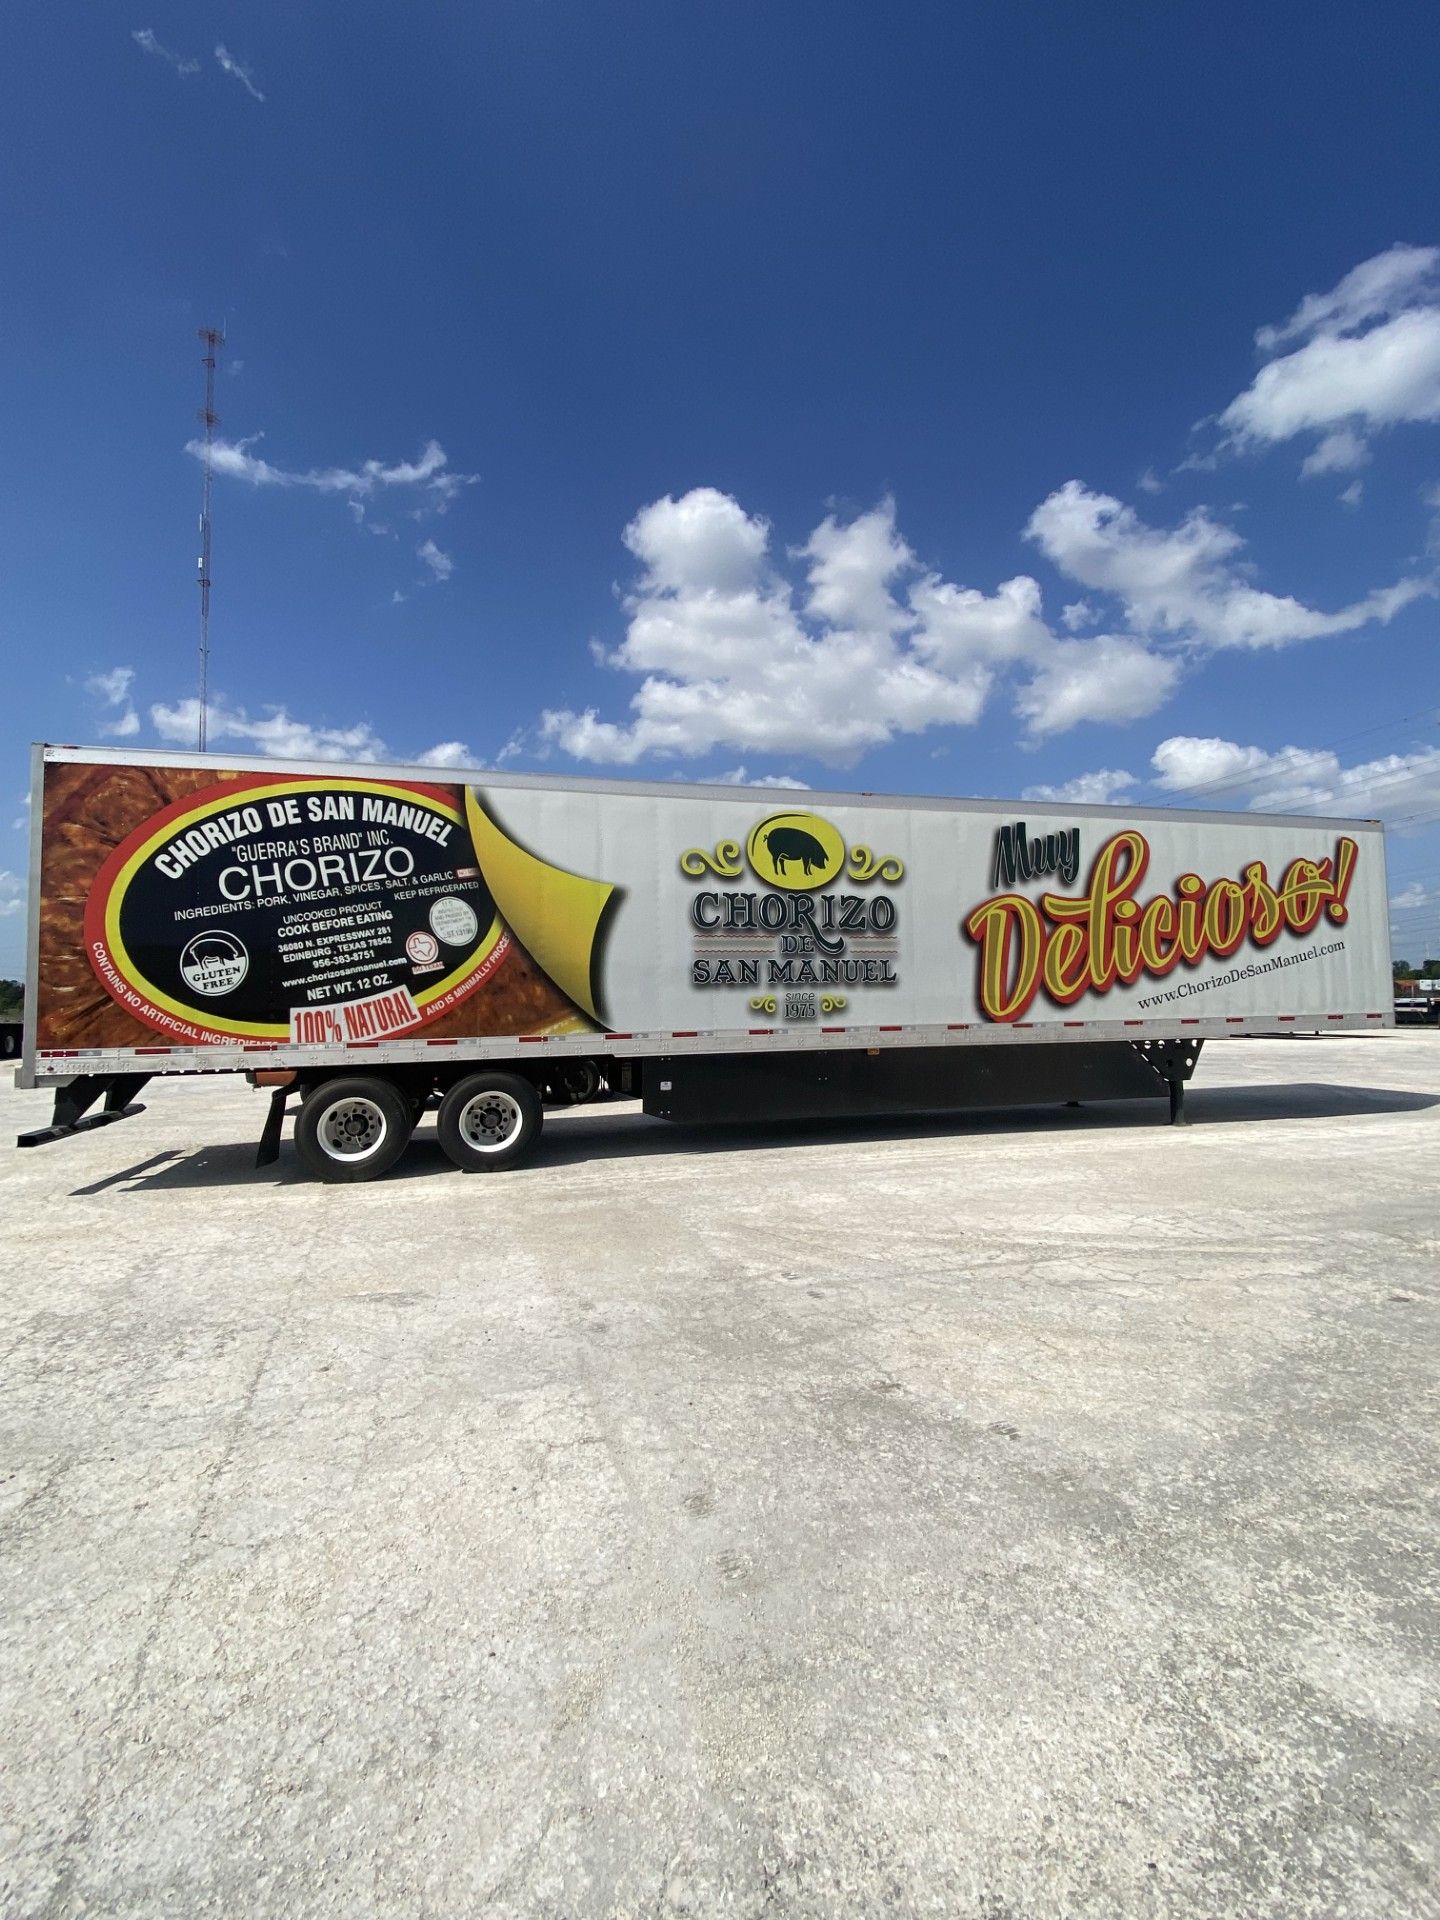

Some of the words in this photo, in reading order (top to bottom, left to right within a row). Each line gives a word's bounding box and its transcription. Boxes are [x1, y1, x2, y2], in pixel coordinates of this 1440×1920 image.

[154, 807, 263, 879] CHORIZO
[266, 799, 302, 828] DE
[306, 796, 355, 823] SAN
[361, 798, 453, 847] MANUEL
[367, 829, 394, 847] INC.
[995, 821, 1080, 888] Muy
[218, 846, 415, 900] CHORIZO
[174, 901, 255, 921] INGREDIENTS:
[412, 876, 419, 885] &
[394, 889, 417, 900] KEEP
[418, 881, 479, 897] REFRIGERATED
[277, 923, 310, 938] COOK
[312, 917, 355, 932] BEFORE
[356, 910, 393, 925] EATING
[283, 907, 337, 924] UNCOOKED
[338, 901, 382, 915] PRODUCT
[692, 891, 896, 954] CHORIZO
[966, 829, 1358, 1022] Delicioso!
[305, 939, 316, 949] N.
[317, 928, 375, 946] EXPRESSWAY
[377, 925, 392, 936] 281
[781, 934, 815, 954] DE
[282, 948, 332, 963] EDINBURG
[338, 940, 367, 953] TEXAS
[193, 966, 241, 982] GLUTEN
[203, 977, 235, 990] FREE
[282, 957, 408, 988] www.chorizosanmanuel.com
[693, 959, 760, 984] SAN
[768, 959, 897, 984] MANUEL
[1137, 939, 1345, 1010] www.ChorizoDeSanManuel.com
[92, 942, 127, 994] CONTAINS
[123, 991, 142, 1008] NO
[139, 1004, 198, 1039] ARTIFICIAL
[201, 1030, 279, 1046] INGREDIE
[306, 985, 331, 1001] NET
[334, 980, 355, 995] WT.
[357, 977, 371, 990] 12
[373, 973, 393, 986] OZ.
[426, 1001, 445, 1016] AND
[445, 994, 455, 1005] IS
[454, 961, 492, 1002] MINIMALLY
[294, 1008, 343, 1043] 100%
[343, 989, 417, 1040] NATURAL
[784, 1003, 816, 1018] 1975
